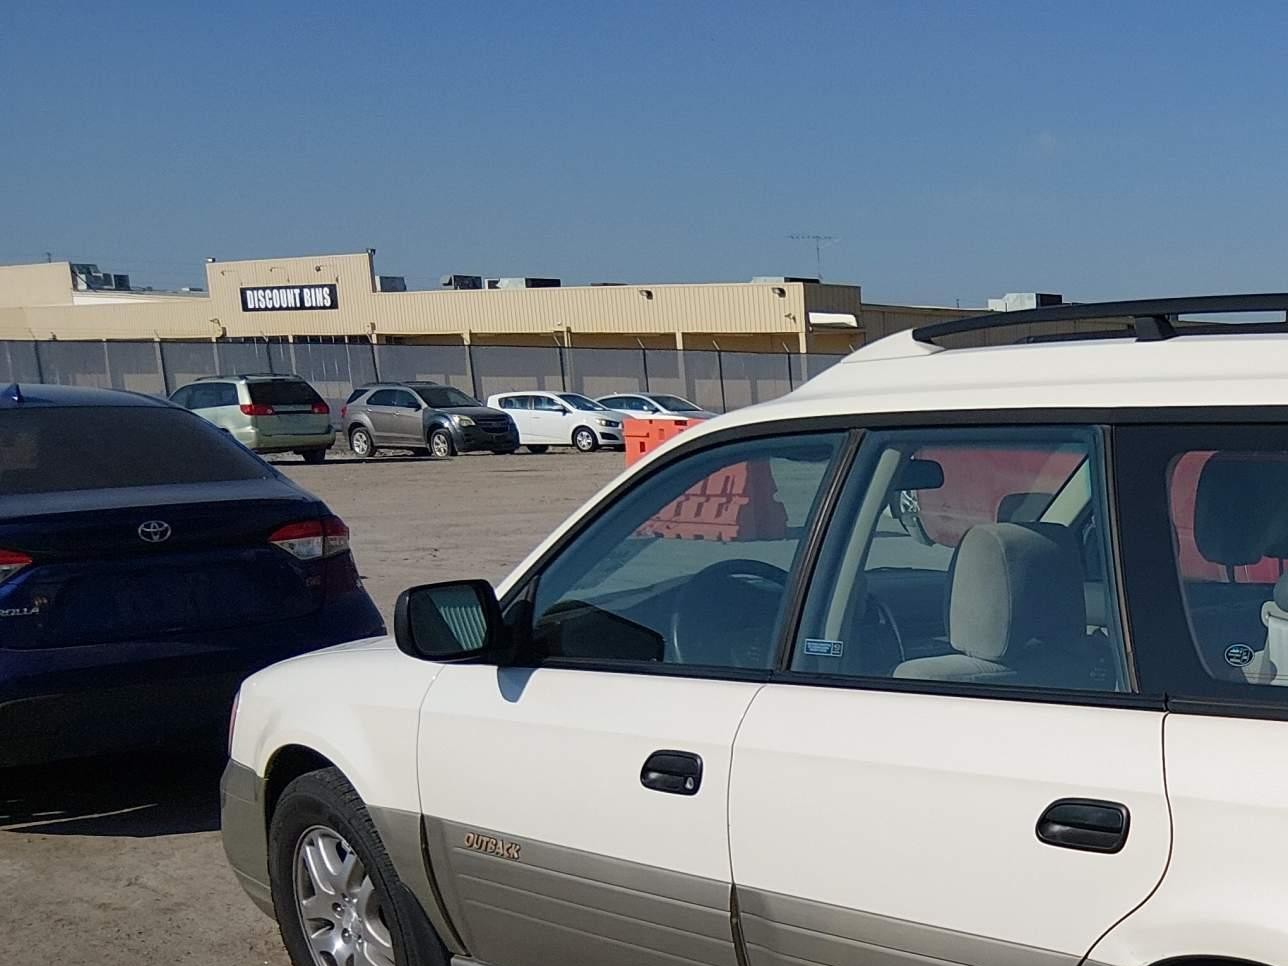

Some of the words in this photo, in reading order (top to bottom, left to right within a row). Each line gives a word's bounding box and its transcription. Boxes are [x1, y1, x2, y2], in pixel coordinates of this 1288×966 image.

[246, 288, 300, 309] DISCOUNT
[302, 287, 331, 307] BINS
[464, 832, 520, 859] OUTBACK
